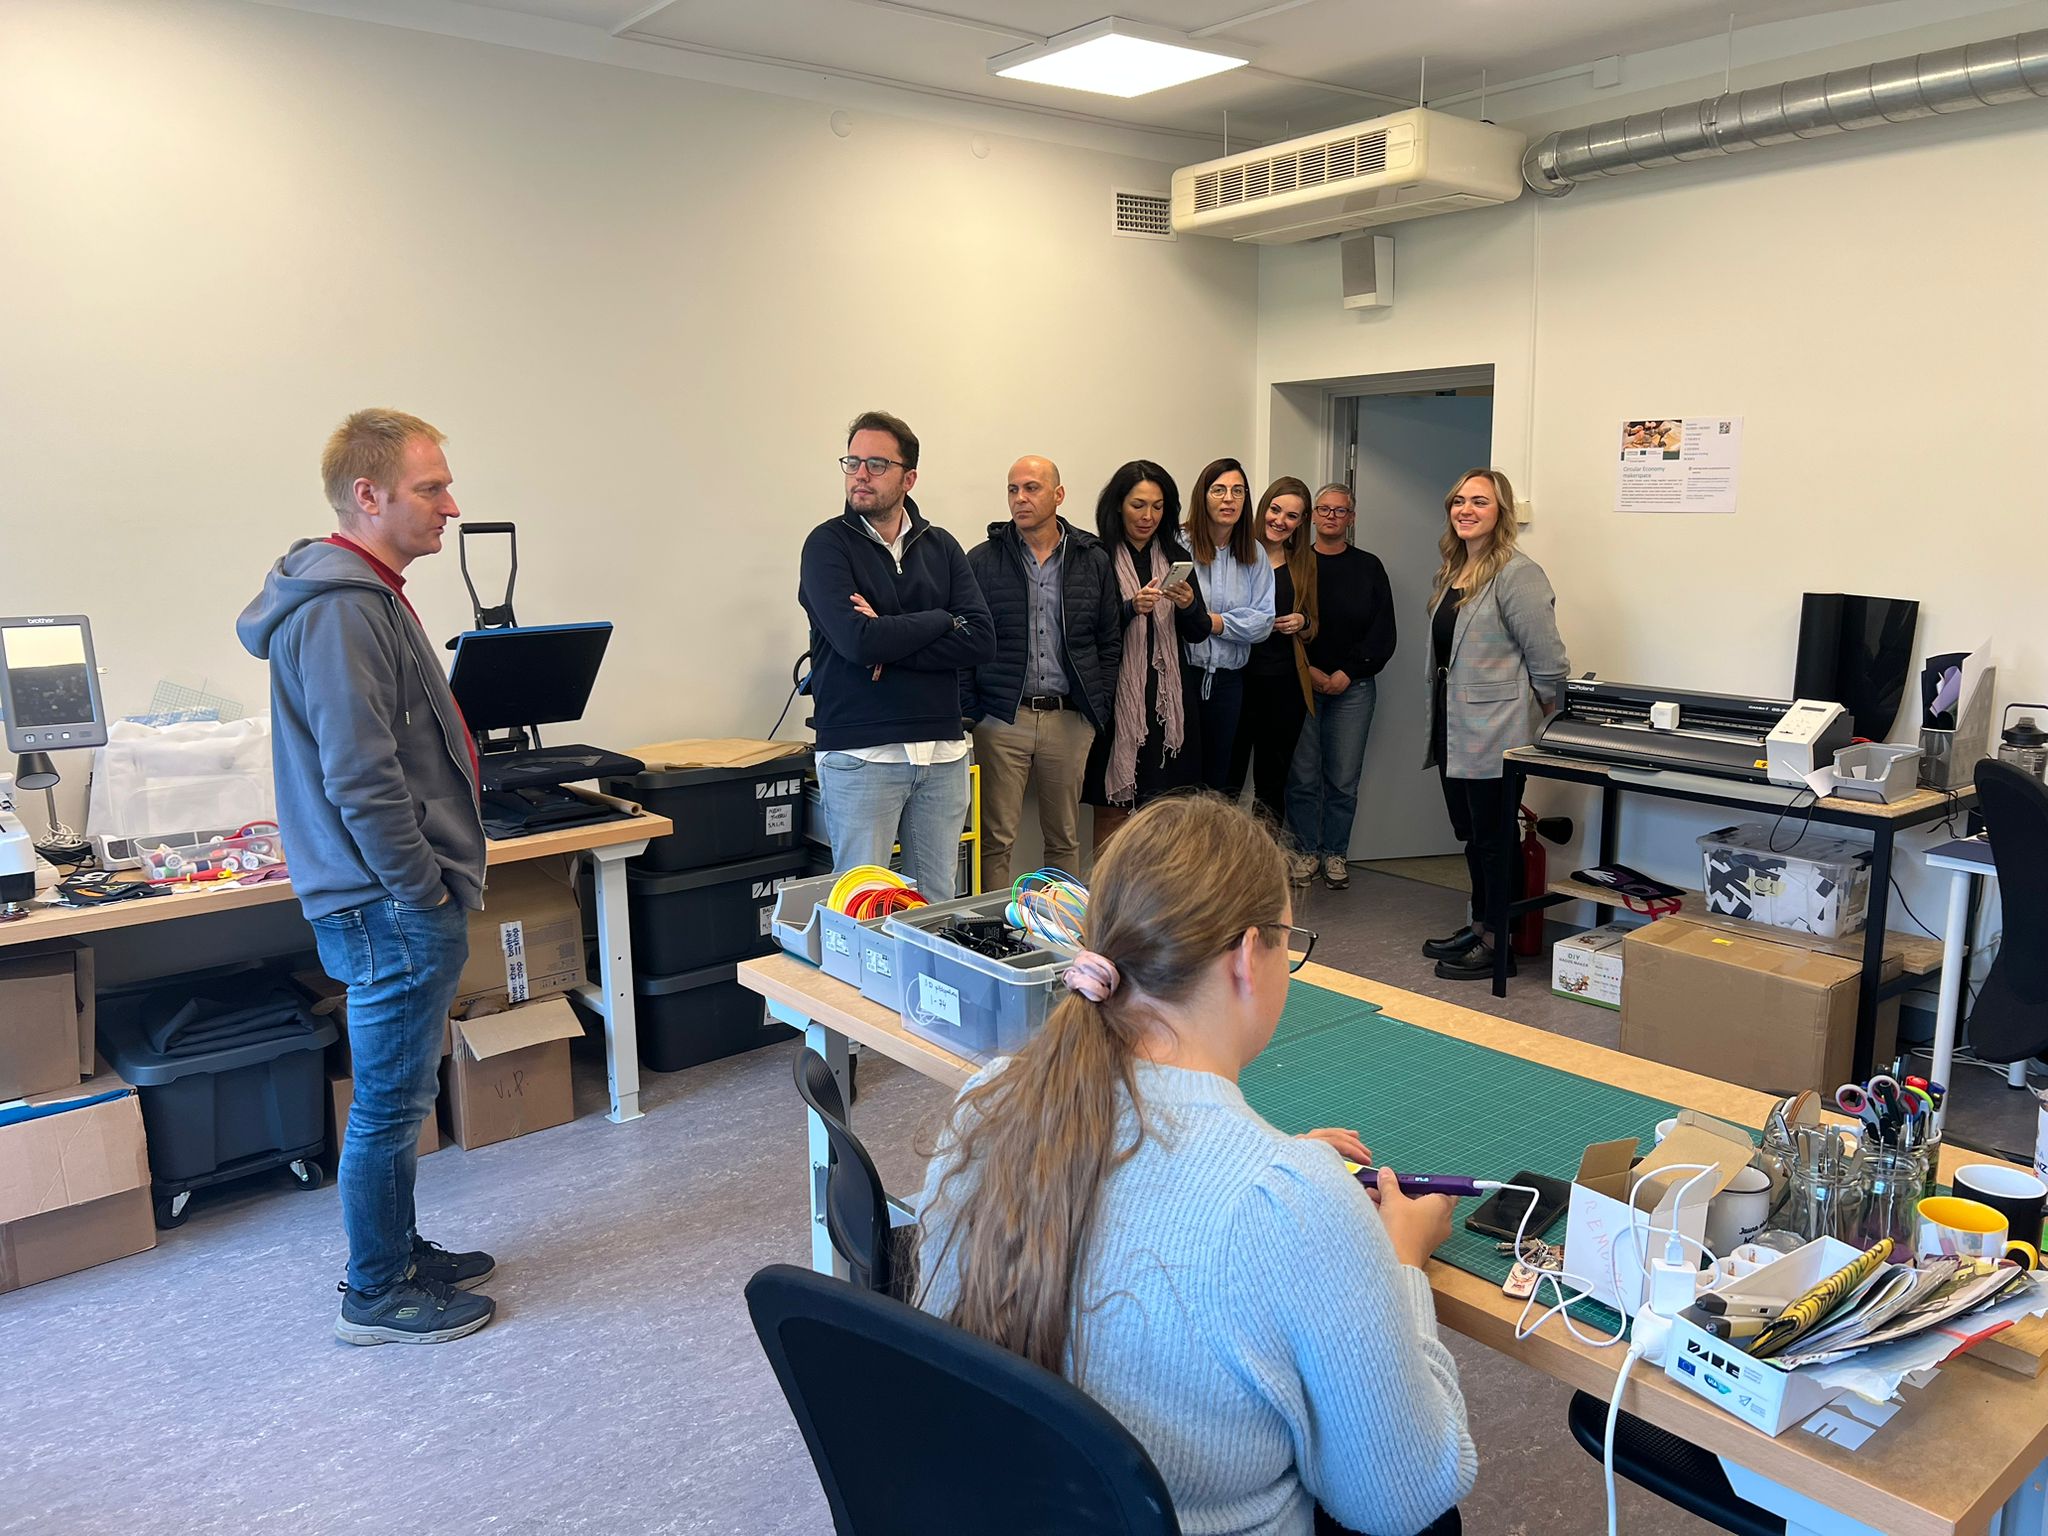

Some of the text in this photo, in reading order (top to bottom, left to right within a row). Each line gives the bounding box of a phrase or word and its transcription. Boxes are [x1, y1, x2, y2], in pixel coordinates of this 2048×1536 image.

[755, 778, 801, 800] DARE
[506, 929, 514, 958] brother
[1687, 1338, 1741, 1379] DARE
